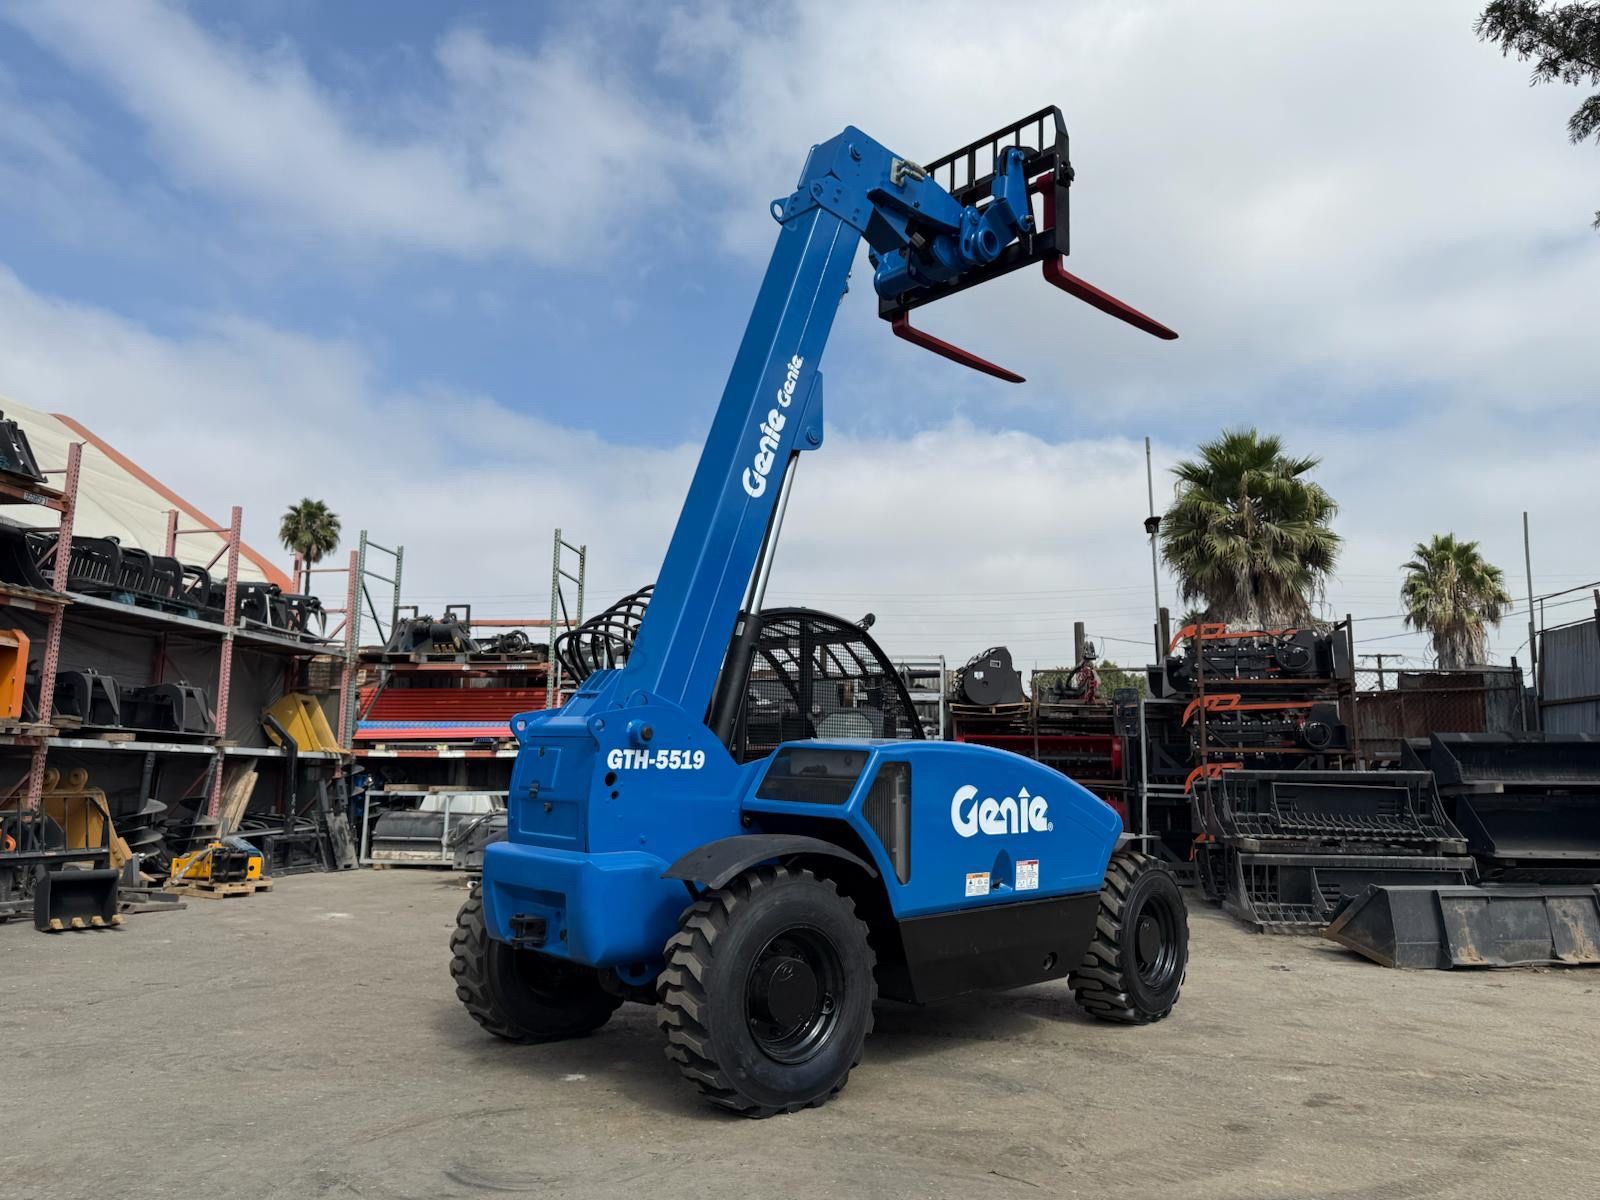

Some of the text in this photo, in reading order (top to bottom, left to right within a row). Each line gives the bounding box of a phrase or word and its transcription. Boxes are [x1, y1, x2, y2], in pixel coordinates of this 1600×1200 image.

[777, 354, 804, 408] Genie
[742, 408, 787, 498] Genie
[607, 748, 706, 770] GTH-5519
[951, 784, 1048, 838] Genie
